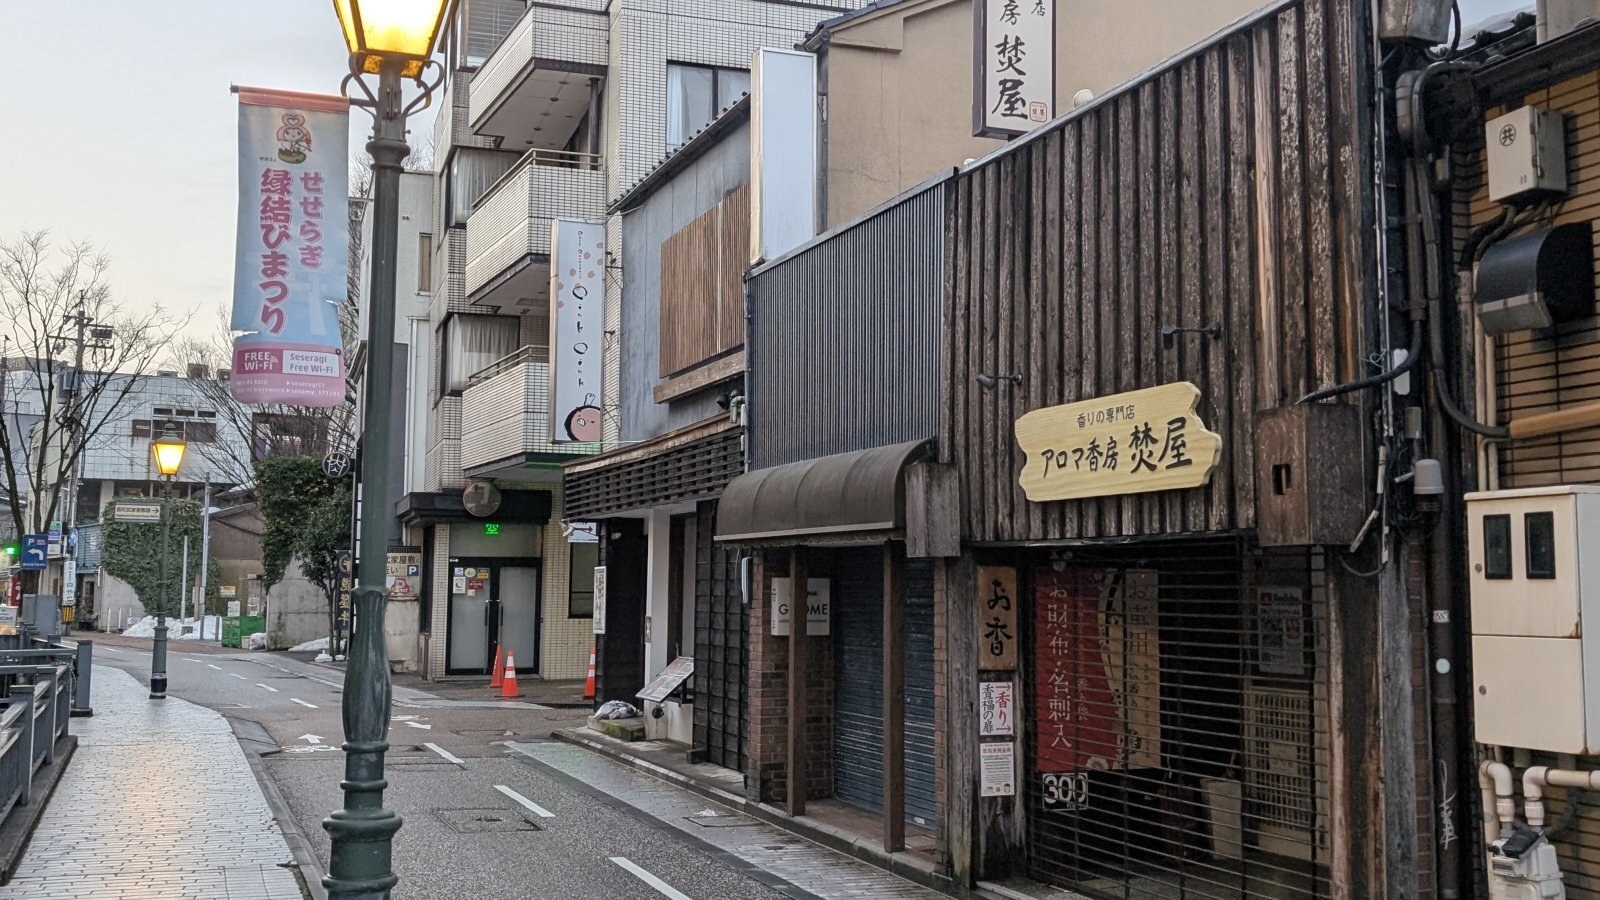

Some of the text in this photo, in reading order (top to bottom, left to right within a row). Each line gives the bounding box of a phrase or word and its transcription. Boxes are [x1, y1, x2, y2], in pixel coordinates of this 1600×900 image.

[1031, 0, 1046, 17] 店
[299, 171, 324, 270] せせらぎ
[259, 167, 292, 335] 縁結びまつり
[244, 351, 271, 361] FREE
[289, 353, 328, 364] Seseragi
[244, 361, 273, 371] Wi-Fi
[289, 363, 334, 375] Free Wi-Fi
[1077, 404, 1135, 428] 香りの専門店
[1041, 416, 1193, 478] アロマ香房 焚屋
[485, 523, 499, 535] 空
[27, 538, 35, 547] P
[408, 566, 417, 575] P
[778, 603, 828, 615] GME
[984, 578, 1013, 657] お香
[995, 690, 1011, 726] 香り
[1044, 775, 1086, 804] 300
